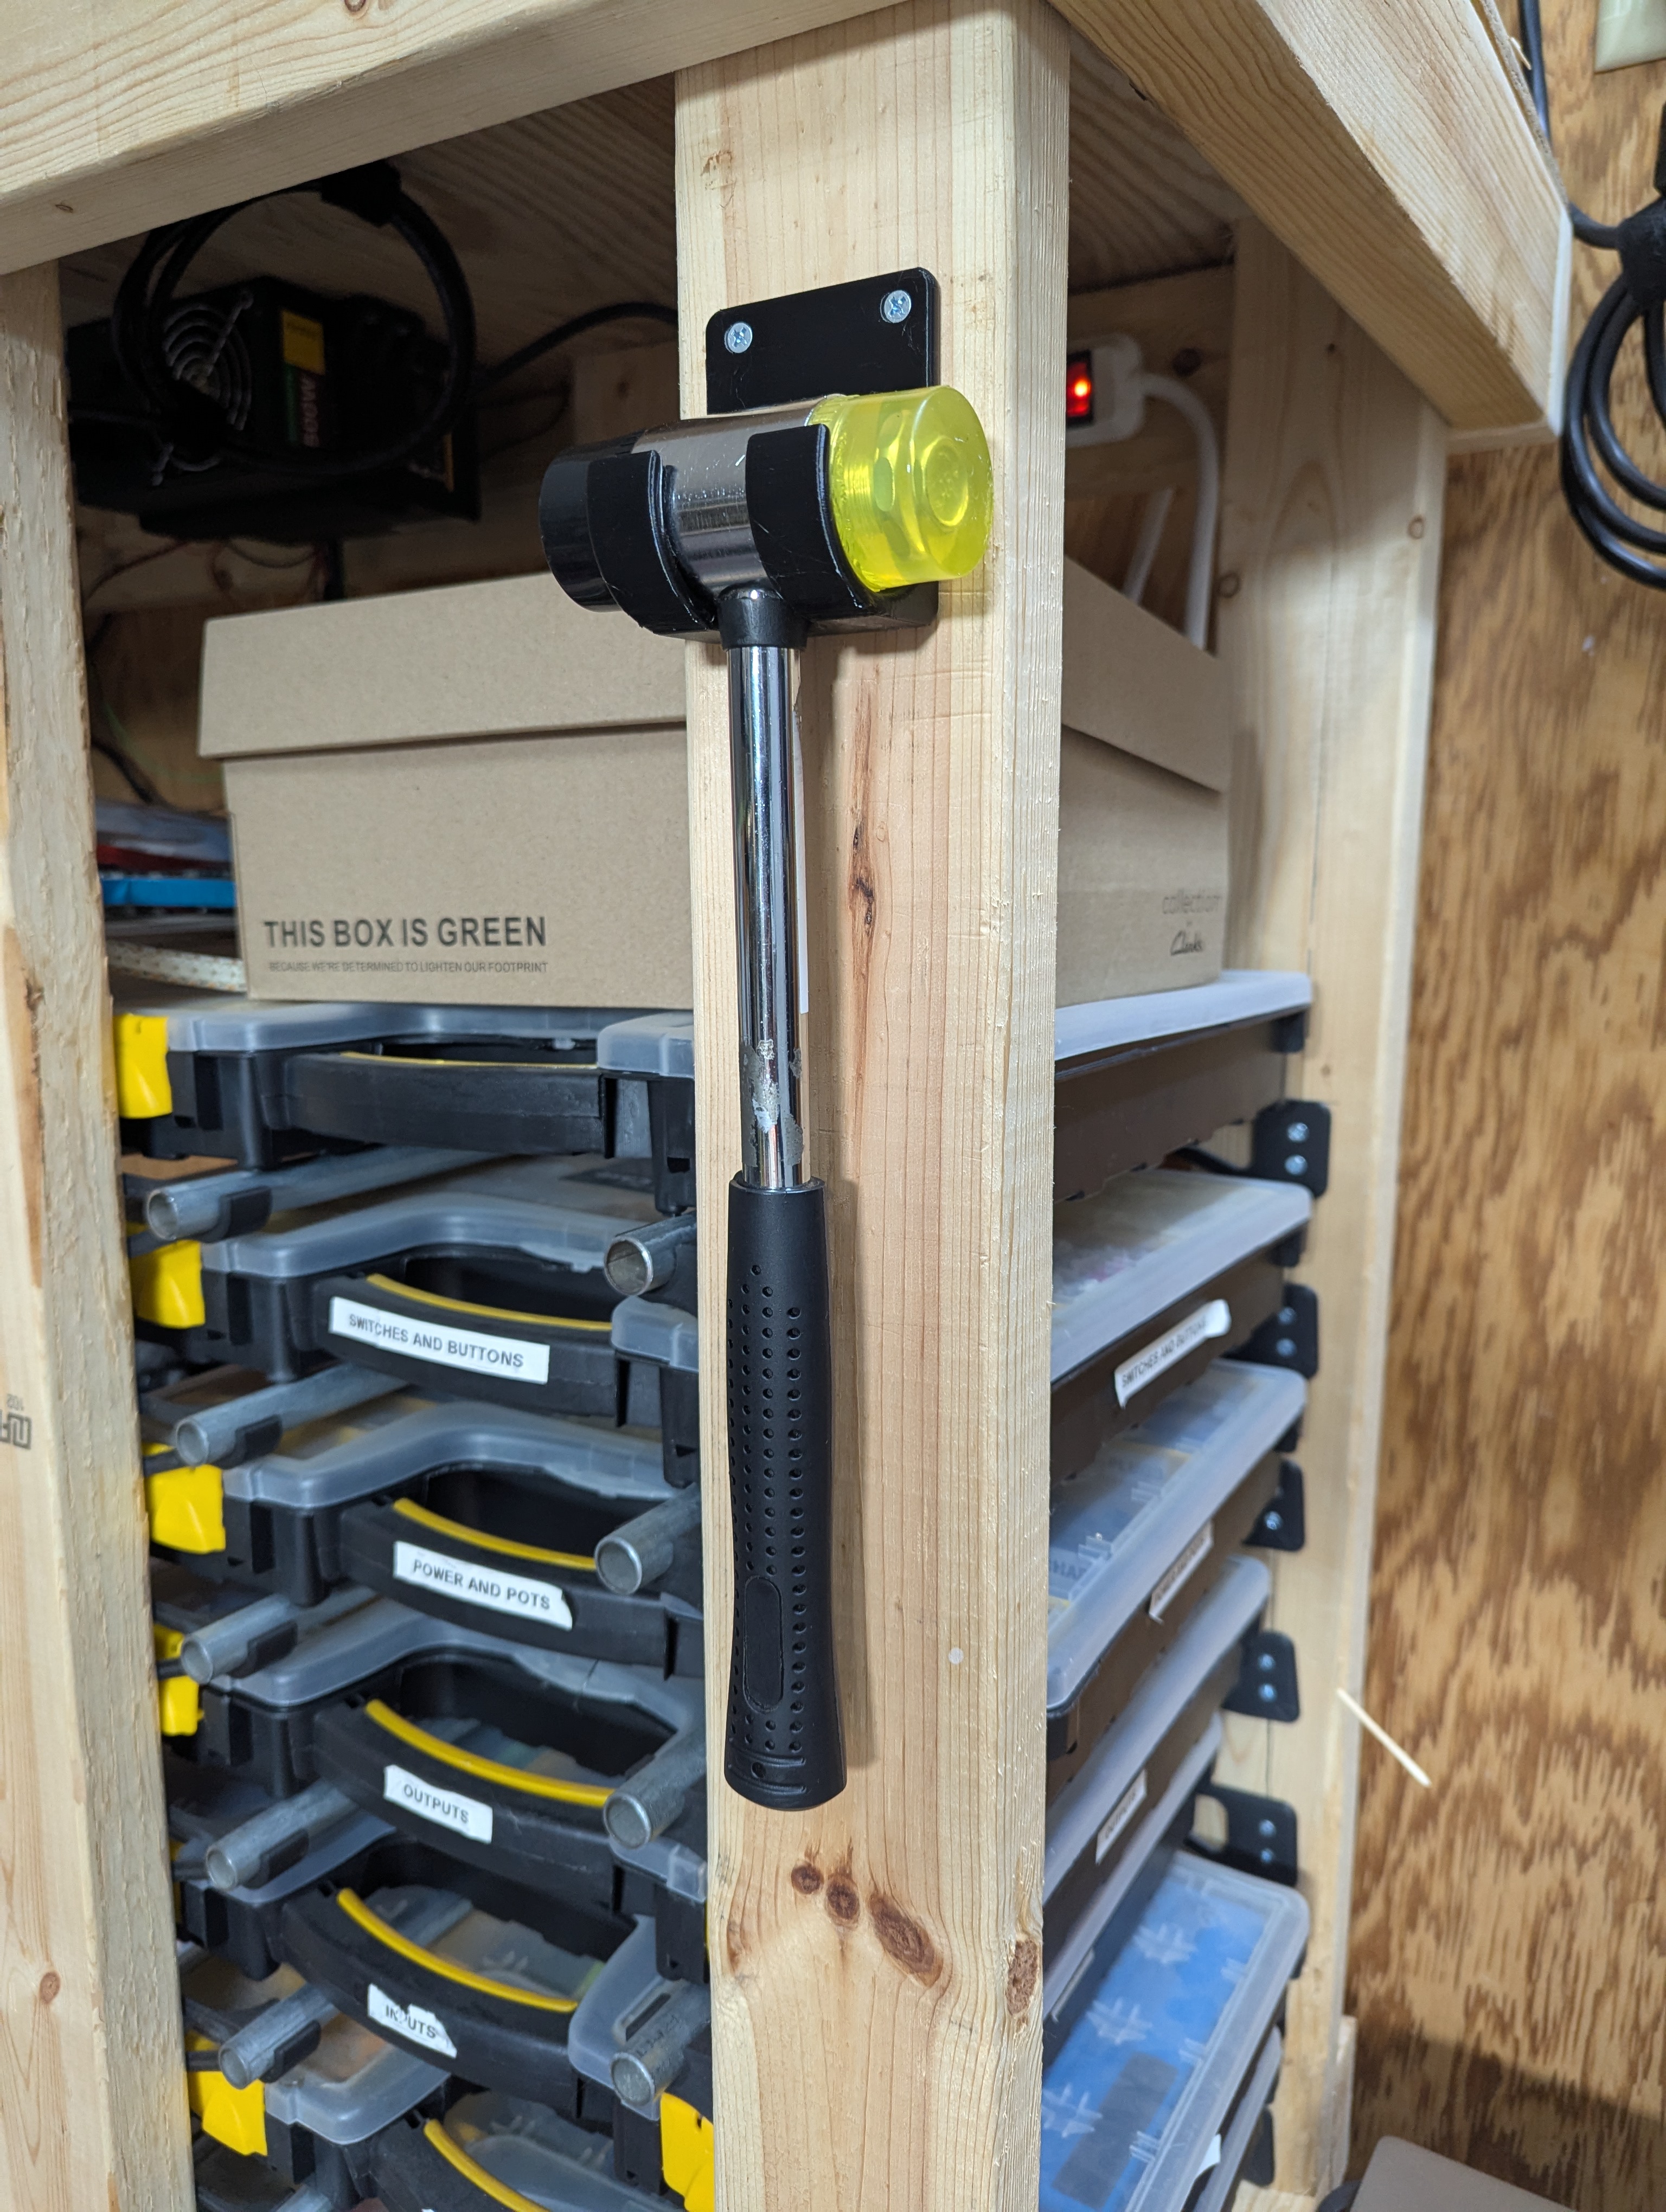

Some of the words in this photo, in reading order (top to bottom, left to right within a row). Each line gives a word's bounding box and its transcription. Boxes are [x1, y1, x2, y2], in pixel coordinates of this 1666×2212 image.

[265, 919, 325, 948] THIS
[334, 918, 394, 948] BOX
[402, 917, 428, 947] IS
[437, 916, 547, 947] GREEN
[269, 961, 310, 972] BECAUSE
[342, 961, 402, 972] DETERMINED
[406, 961, 418, 972] TO
[420, 961, 462, 972] LIGHTEN
[464, 961, 486, 972] OUR
[488, 961, 548, 973] FOOTPRINT
[349, 1314, 408, 1342] SWITCHES
[413, 1332, 443, 1351] AND
[447, 1340, 524, 1368] BUTTONS
[413, 1559, 464, 1587] POWER
[468, 1577, 501, 1598] AND
[507, 1586, 550, 1610] POTS
[403, 1784, 470, 1824] OUTPUTS
